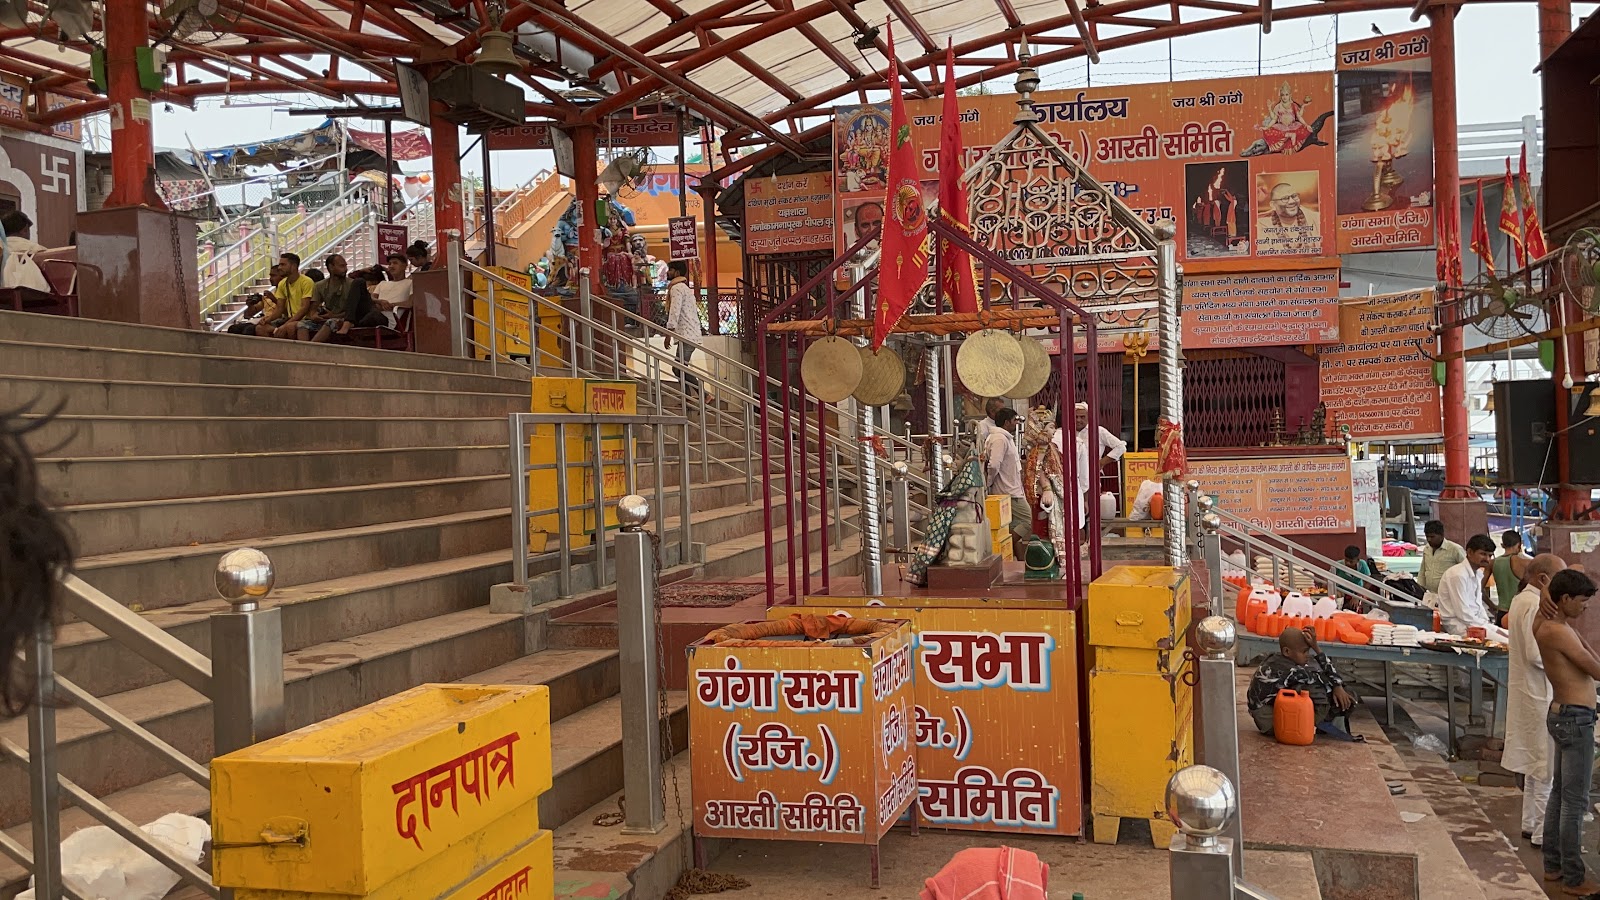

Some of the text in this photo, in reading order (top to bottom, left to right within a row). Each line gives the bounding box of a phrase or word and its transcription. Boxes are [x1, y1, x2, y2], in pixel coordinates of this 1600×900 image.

[1342, 50, 1370, 63] जय
[1375, 41, 1395, 59] श्री
[1172, 97, 1195, 108] जय
[1199, 92, 1215, 106] श्री
[612, 119, 675, 134] महादेव
[913, 115, 935, 126] जय
[1096, 121, 1233, 162] आरती समिति
[1342, 210, 1430, 228] गंगा सभा (रजि.)
[1352, 229, 1420, 246] आरती समिति
[592, 386, 626, 412] दानपात्र
[1128, 461, 1158, 474] दानपा
[1275, 516, 1338, 529] आरती समिति
[922, 634, 1047, 686] सभा
[696, 656, 862, 709] गंगा सभा
[915, 705, 971, 758] जि.)
[723, 723, 838, 782] (रजि.)
[391, 731, 520, 851] दानपात्र
[918, 767, 1055, 824] समिति
[704, 791, 865, 832] आरती समिति
